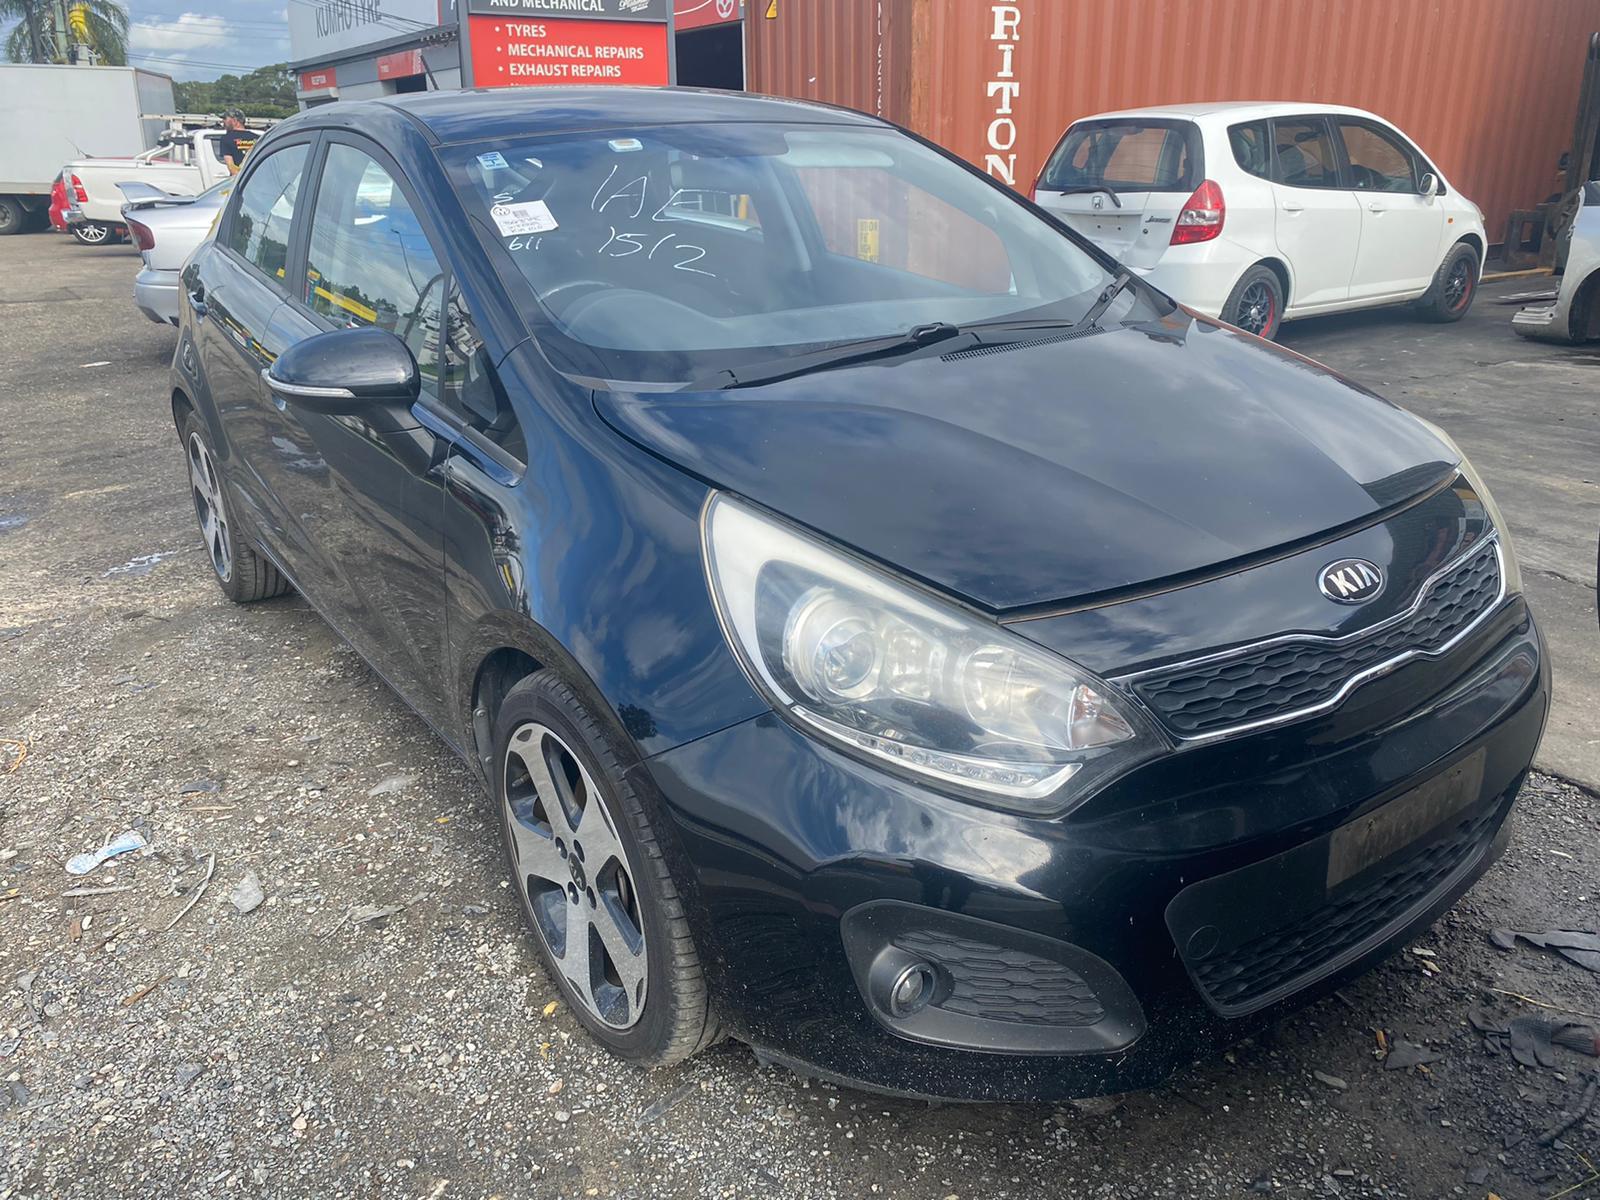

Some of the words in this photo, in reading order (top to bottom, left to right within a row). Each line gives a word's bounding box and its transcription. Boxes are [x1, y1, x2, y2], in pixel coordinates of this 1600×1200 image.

[522, 0, 605, 12] MECHANICAL
[505, 23, 547, 37] TYRES
[507, 43, 592, 58] MECHANICAL
[595, 47, 644, 59] REPAIRS
[509, 63, 568, 76] EXHAUST
[571, 65, 621, 77] REPAIRS
[508, 236, 542, 251] 611
[1327, 563, 1380, 597] KIA
